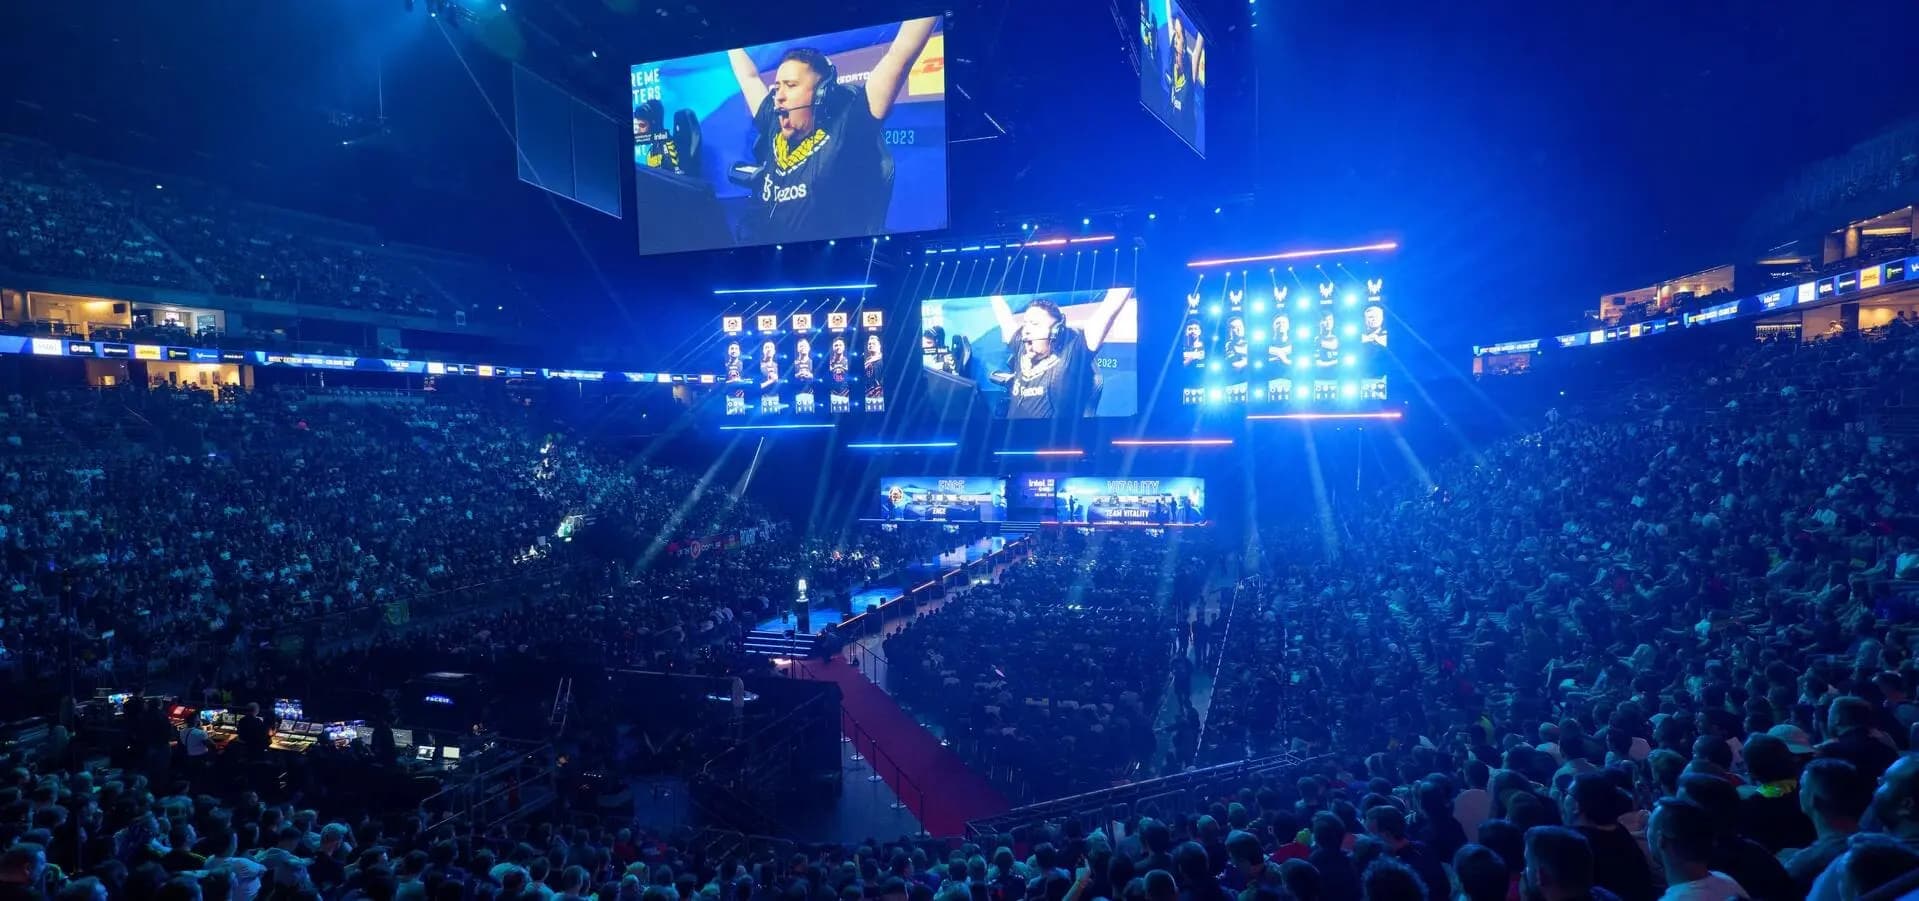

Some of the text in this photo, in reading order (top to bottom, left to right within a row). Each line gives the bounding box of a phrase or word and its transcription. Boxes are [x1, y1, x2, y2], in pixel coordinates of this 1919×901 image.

[885, 130, 914, 145] 2023
[1097, 358, 1118, 368] 2023
[1123, 509, 1149, 517] VITALITY
